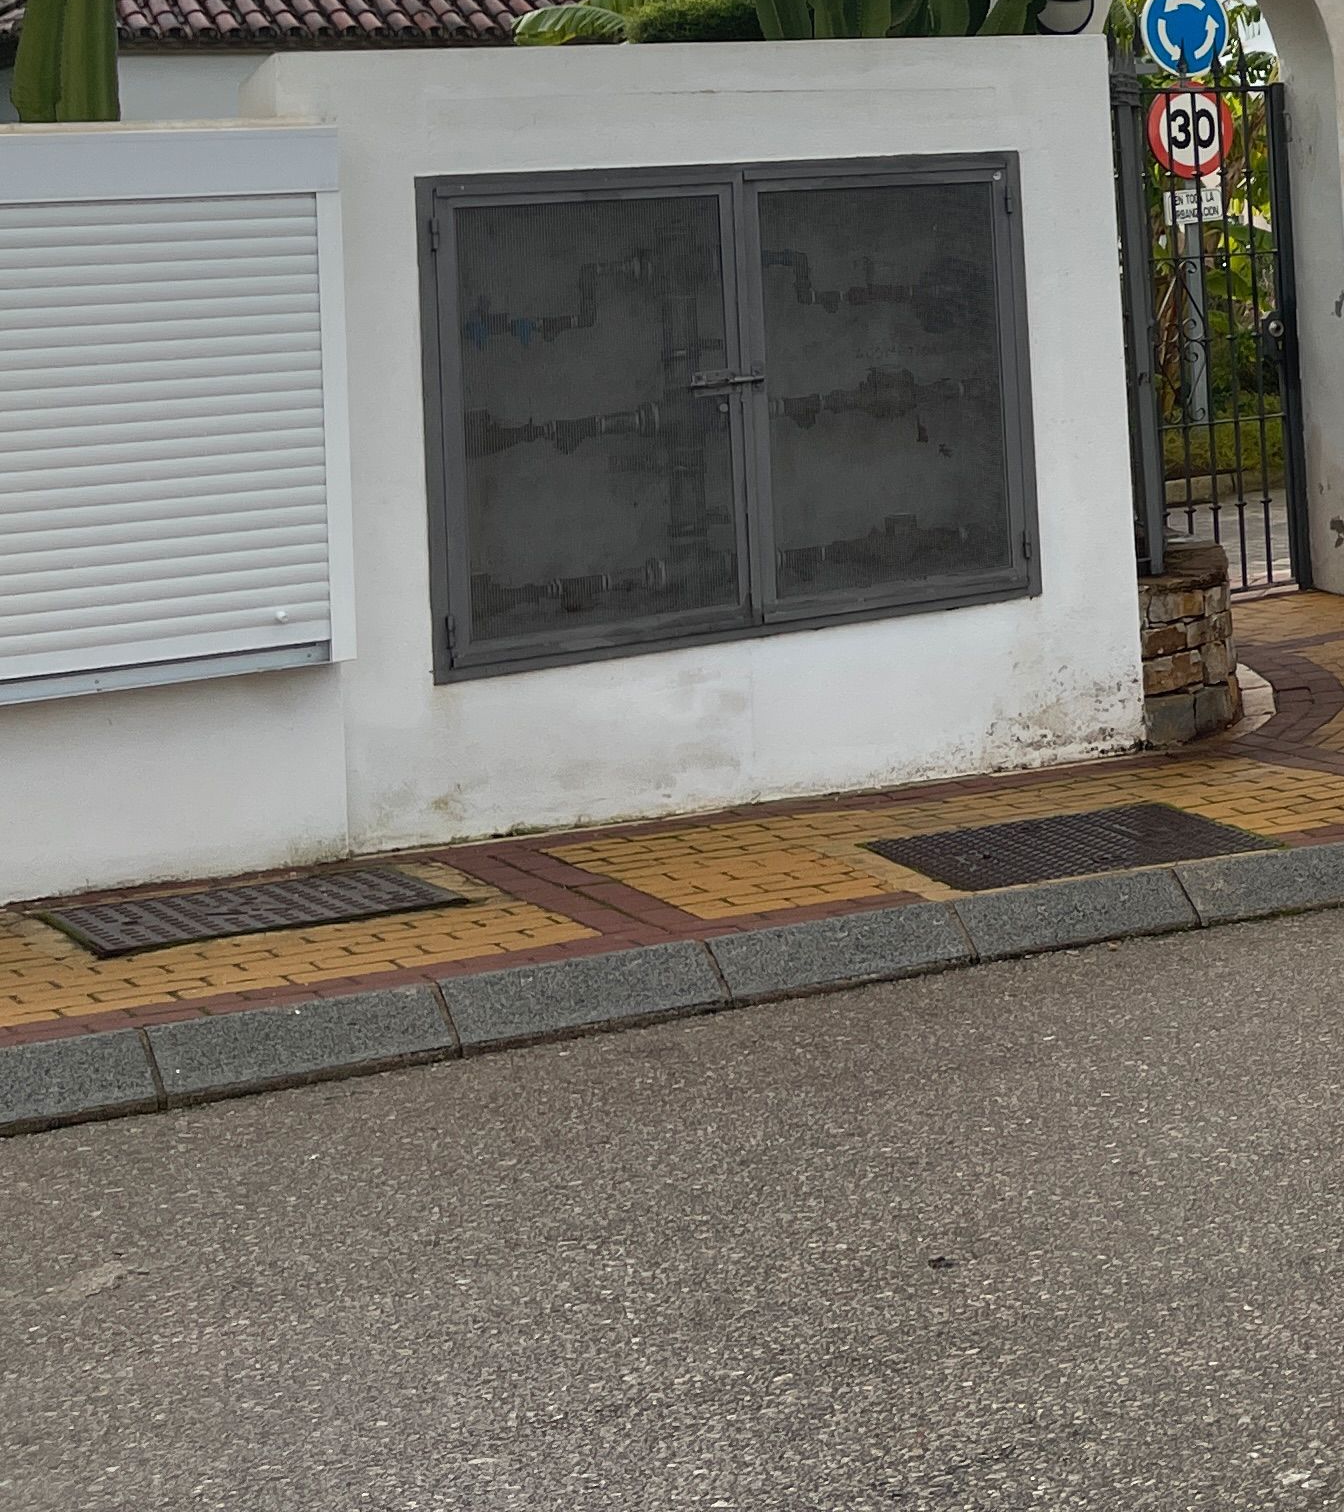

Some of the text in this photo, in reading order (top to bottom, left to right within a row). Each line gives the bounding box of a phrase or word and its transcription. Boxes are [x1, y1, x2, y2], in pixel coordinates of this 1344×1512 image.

[1169, 108, 1215, 149] 30
[1186, 193, 1203, 204] TOD
[1206, 191, 1215, 202] LA
